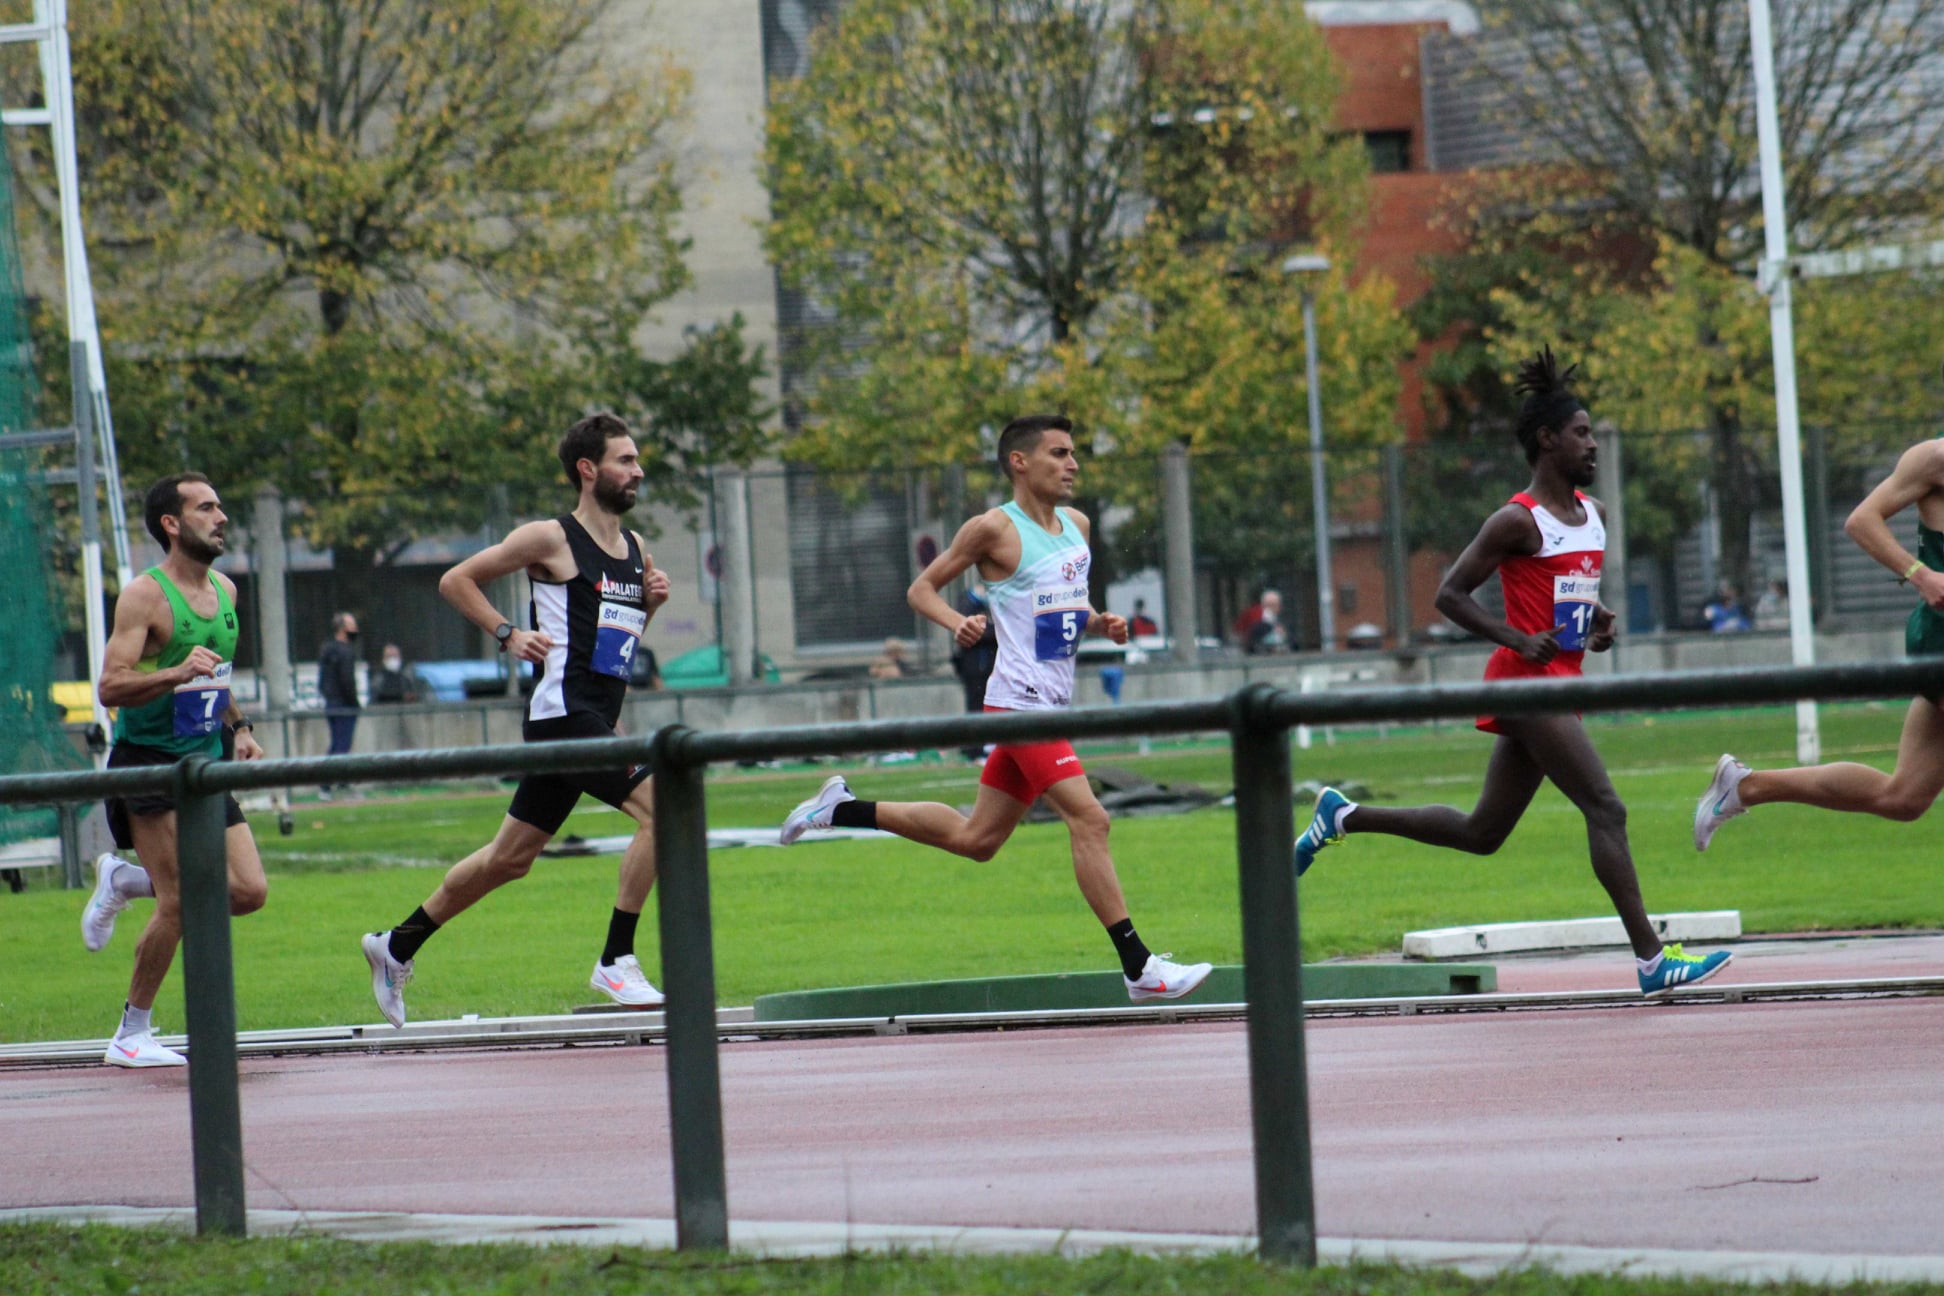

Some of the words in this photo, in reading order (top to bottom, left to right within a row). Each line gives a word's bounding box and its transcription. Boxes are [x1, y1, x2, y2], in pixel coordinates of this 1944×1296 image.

[1560, 581, 1575, 593] gd
[1038, 593, 1053, 606] gd
[604, 608, 619, 620] gd
[1062, 612, 1077, 641] 5
[619, 635, 636, 663] 4
[201, 690, 219, 718] 7
